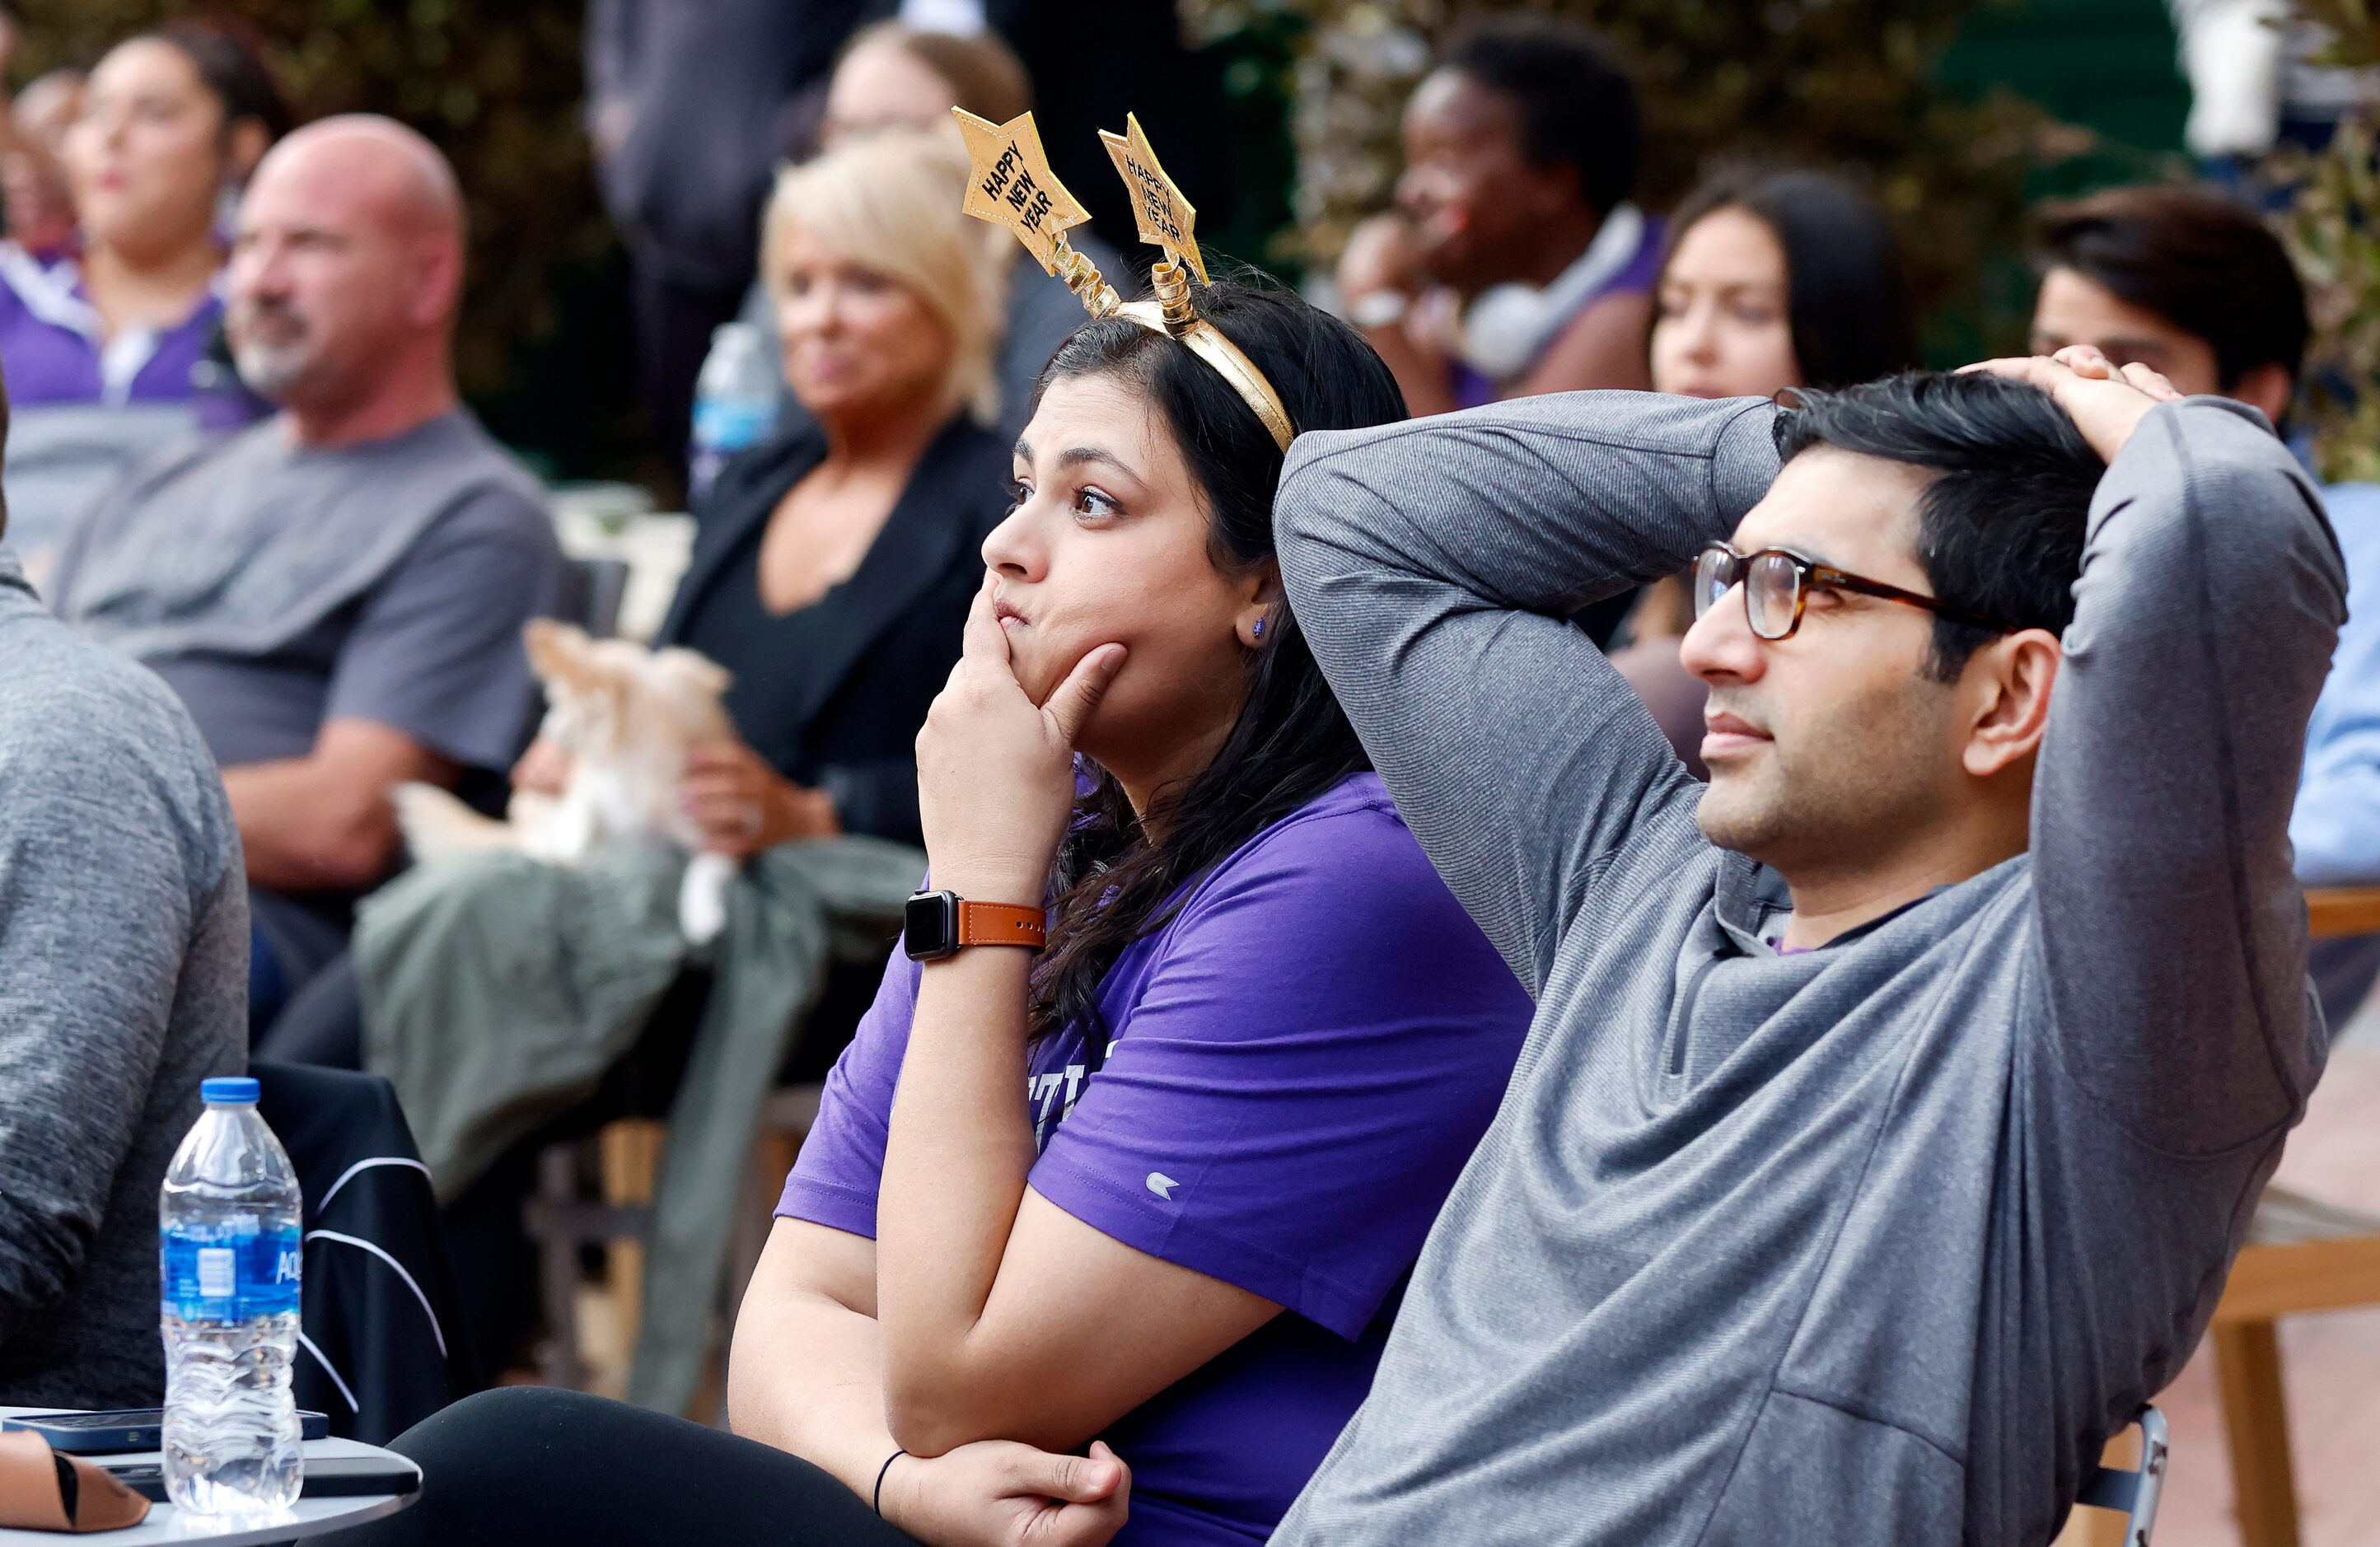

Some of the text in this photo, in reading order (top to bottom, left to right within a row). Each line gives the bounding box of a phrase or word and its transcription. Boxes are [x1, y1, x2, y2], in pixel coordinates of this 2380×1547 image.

[981, 139, 1023, 202] HAPPY
[1006, 169, 1036, 213] NEW
[1125, 154, 1171, 203] HAPPY
[1020, 190, 1053, 235] YEAR
[1140, 183, 1174, 222] NEW
[1142, 202, 1183, 244] YEAR
